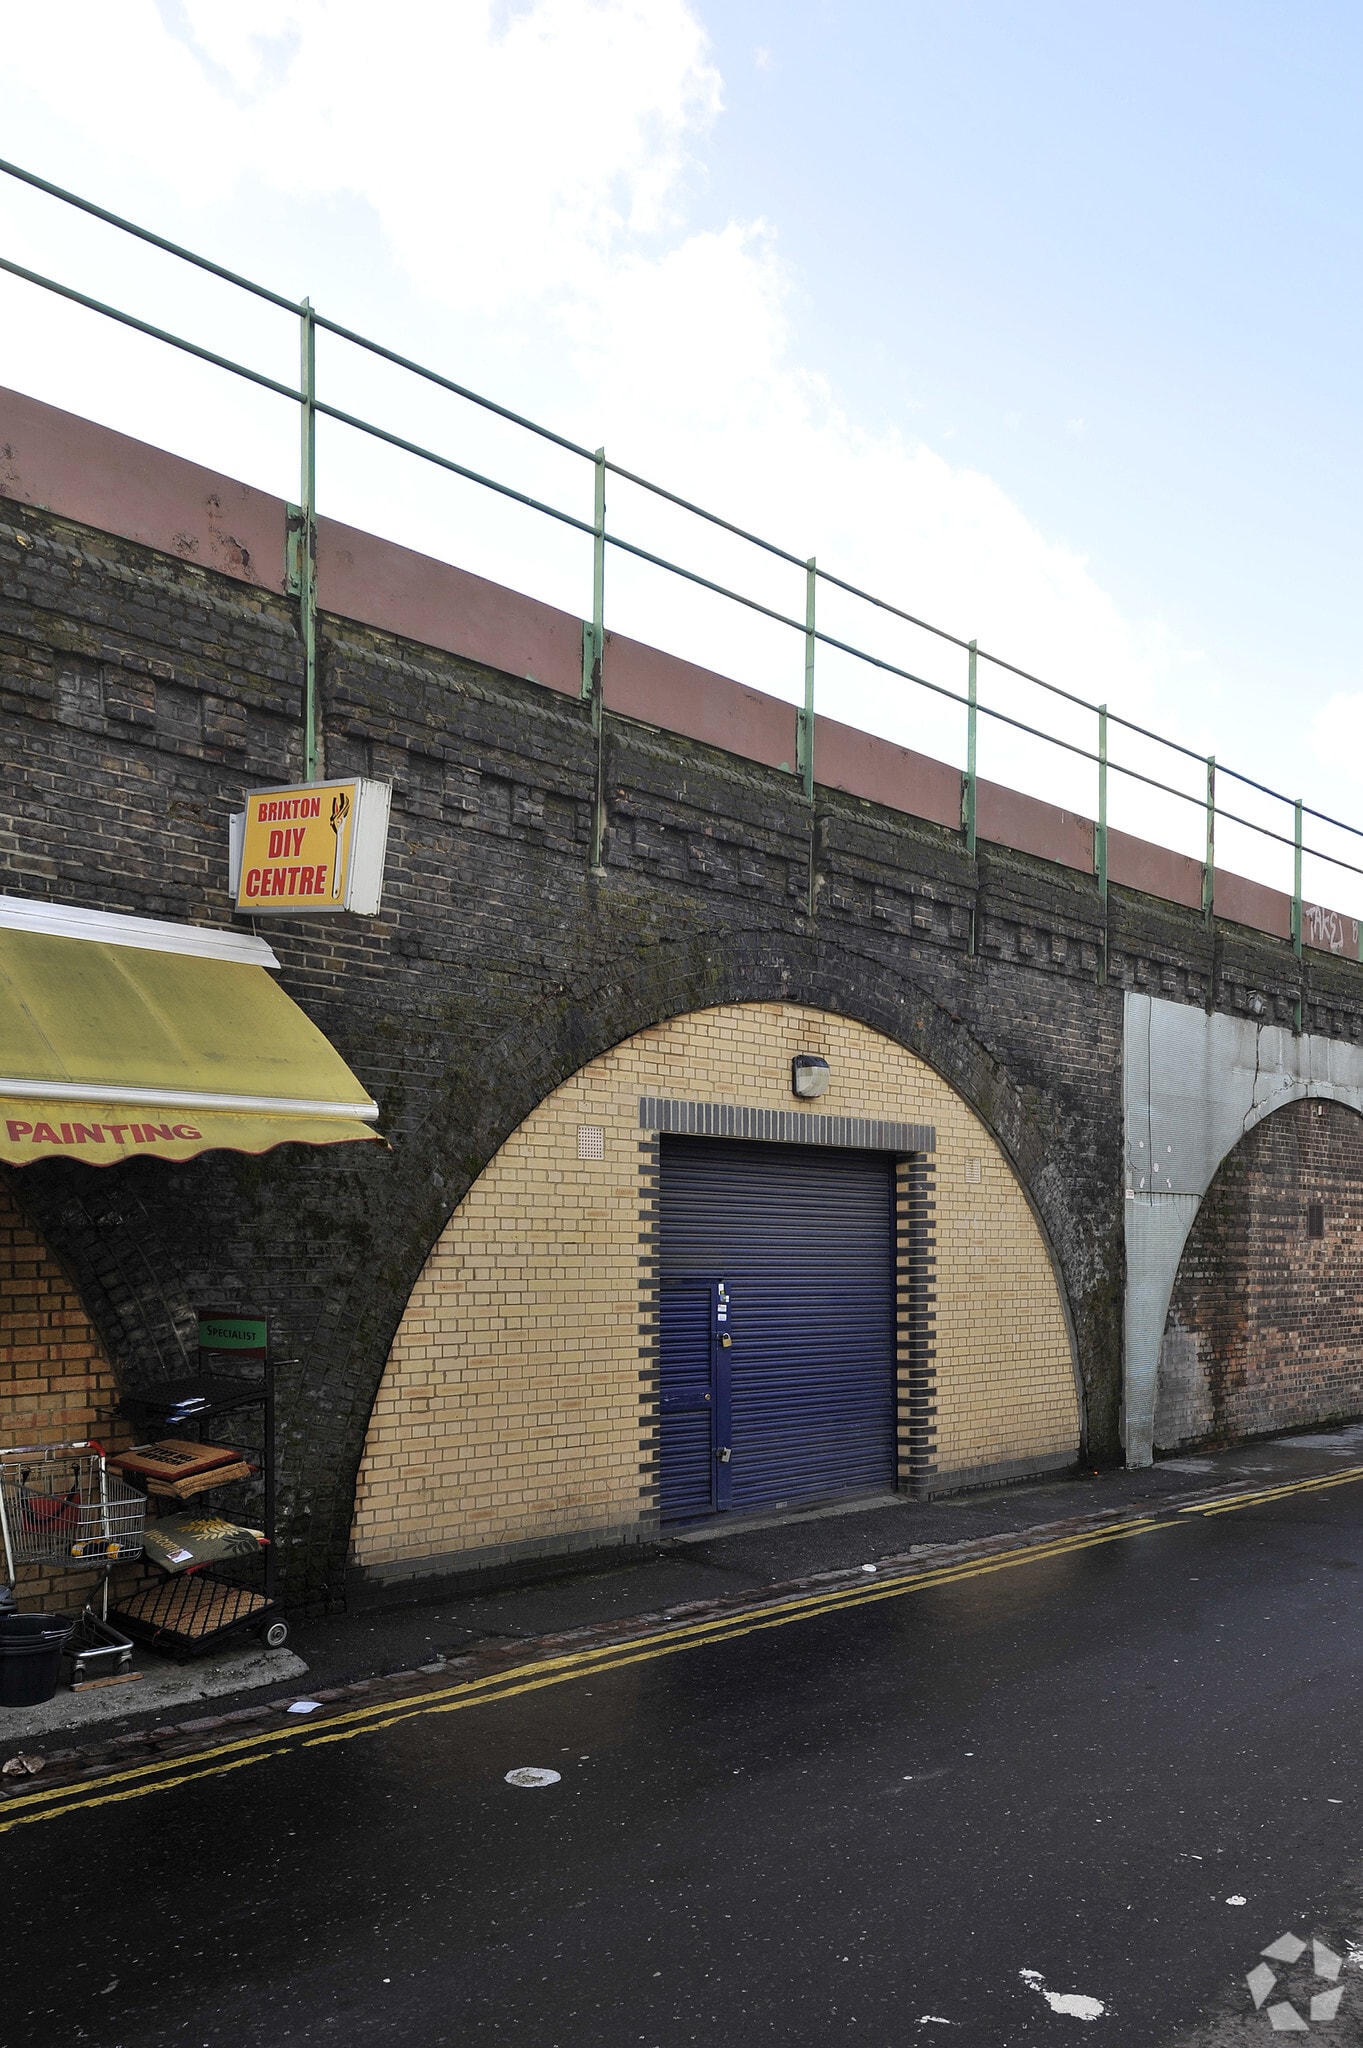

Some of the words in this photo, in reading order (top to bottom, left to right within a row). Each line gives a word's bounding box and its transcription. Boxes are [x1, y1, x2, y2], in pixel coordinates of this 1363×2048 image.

[257, 796, 321, 822] BRIXTON
[268, 827, 306, 859] DIY
[245, 865, 328, 898] CENTRE
[6, 1120, 203, 1145] PAINTING
[206, 1325, 257, 1341] SPECIALIST
[143, 1528, 180, 1550] Welcom
